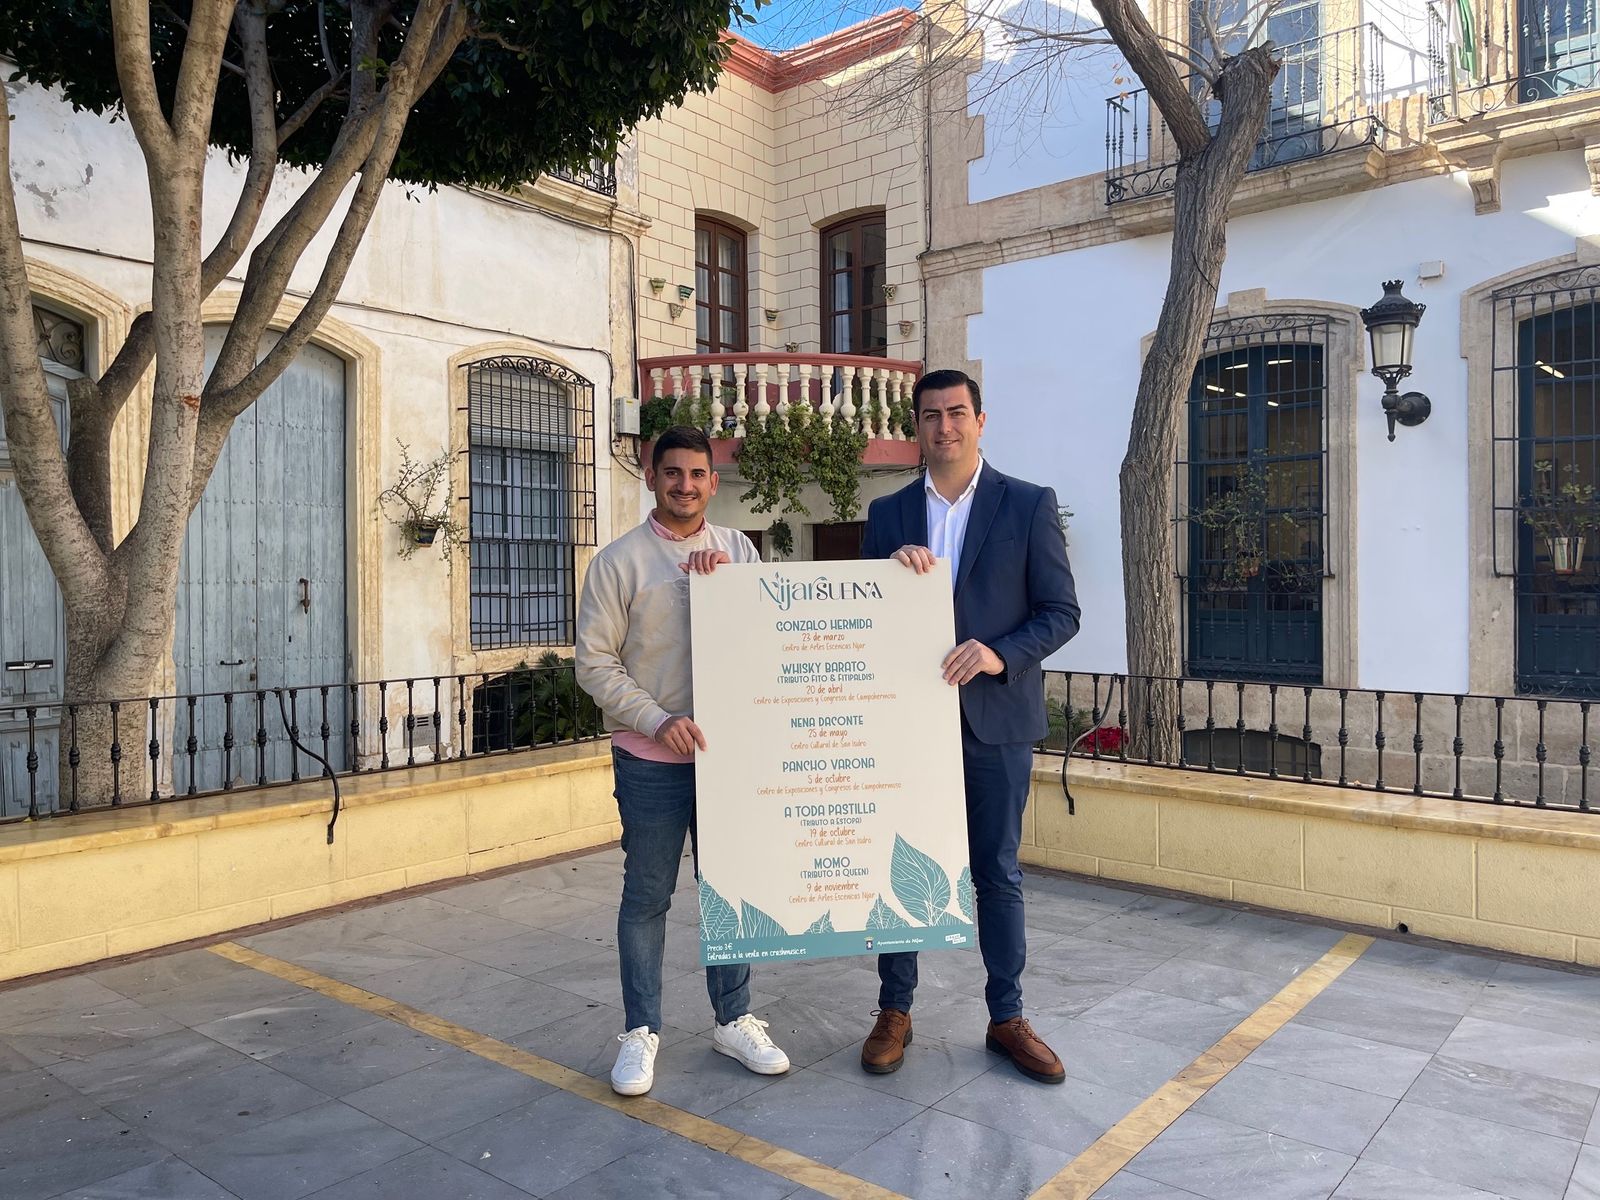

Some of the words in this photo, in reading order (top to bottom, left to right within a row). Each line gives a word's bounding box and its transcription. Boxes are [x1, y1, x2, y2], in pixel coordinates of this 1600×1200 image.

[776, 620, 827, 631] GONZALO
[831, 619, 873, 630] HERMIDA
[802, 633, 810, 641] 23
[813, 633, 821, 641] de
[783, 643, 800, 652] Centro
[781, 663, 821, 674] WHISKY
[825, 661, 866, 673] BARATO
[777, 676, 809, 684] (TRIBUTO
[812, 675, 827, 683] FITO
[838, 673, 875, 681] FITIPALDIS)
[806, 685, 815, 694] 20
[818, 685, 825, 694] de
[828, 684, 843, 694] abril
[754, 697, 771, 705] Centro
[781, 697, 813, 706] Exposiciones
[815, 697, 819, 706] y
[820, 695, 847, 704] Congresos
[791, 718, 815, 728] NENA
[819, 716, 863, 727] DACONTE
[808, 729, 817, 738] 25
[819, 728, 828, 737] de
[830, 729, 848, 741] mayo
[791, 742, 808, 750] Centro
[810, 740, 830, 750] Cultural
[832, 740, 839, 748] de
[840, 740, 851, 748] San
[783, 760, 827, 772] PANCHO
[831, 758, 875, 770] VARONA
[808, 775, 813, 784] 5
[815, 774, 822, 783] de
[825, 773, 851, 782] octubre
[757, 788, 775, 796] Centro
[785, 787, 817, 797] Exposiciones
[820, 787, 823, 795] y
[825, 785, 852, 795] Congresos
[784, 807, 791, 818] A
[795, 805, 825, 817] TODA
[829, 802, 876, 815] PASTILLA
[800, 819, 828, 827] (TRIBUTO
[836, 817, 862, 825] ESTOPA)
[810, 829, 817, 838] 19
[820, 828, 827, 837] de
[830, 827, 855, 836] octubre
[795, 839, 813, 848] Centro
[815, 838, 835, 847] Cultural
[845, 837, 856, 845] San
[814, 857, 850, 869] MOMO
[800, 870, 833, 879] (TRIBUTO
[843, 868, 869, 877] QUEEN)
[807, 884, 811, 892] 9
[814, 883, 822, 891] de
[825, 881, 859, 891] noviembre
[789, 895, 807, 904] Centro
[809, 894, 816, 902] de
[818, 894, 834, 902] Artes
[708, 952, 731, 960] Entradas
[745, 950, 760, 958] venta
